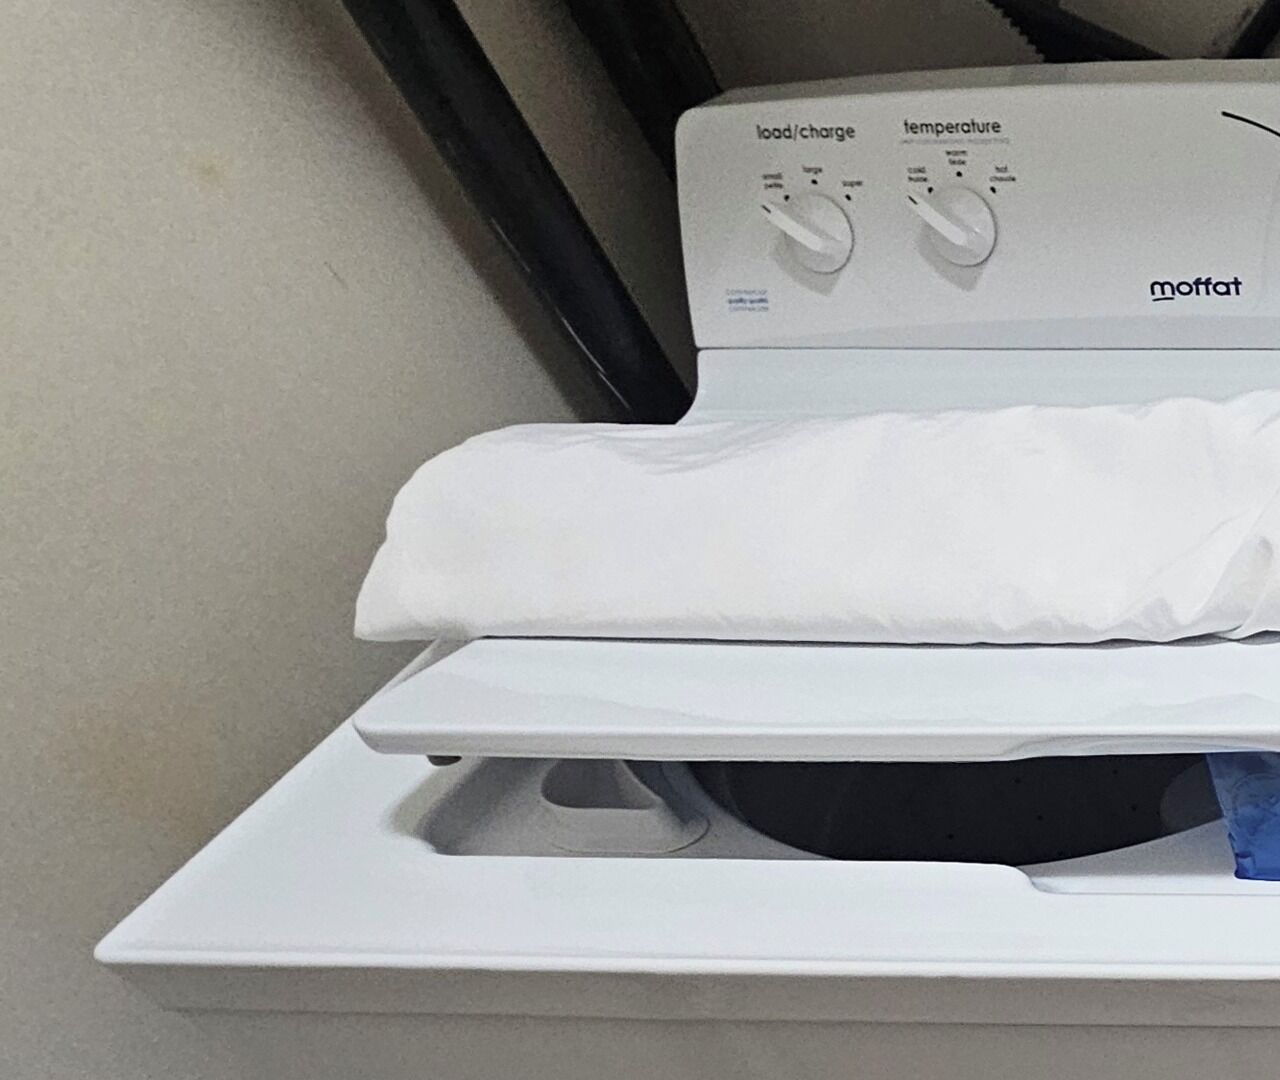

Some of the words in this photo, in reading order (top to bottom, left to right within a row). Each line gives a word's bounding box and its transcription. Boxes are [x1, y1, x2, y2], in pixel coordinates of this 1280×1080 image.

[756, 123, 856, 142] load/charge
[903, 118, 1002, 137] temperature
[1150, 276, 1243, 302] moffat
